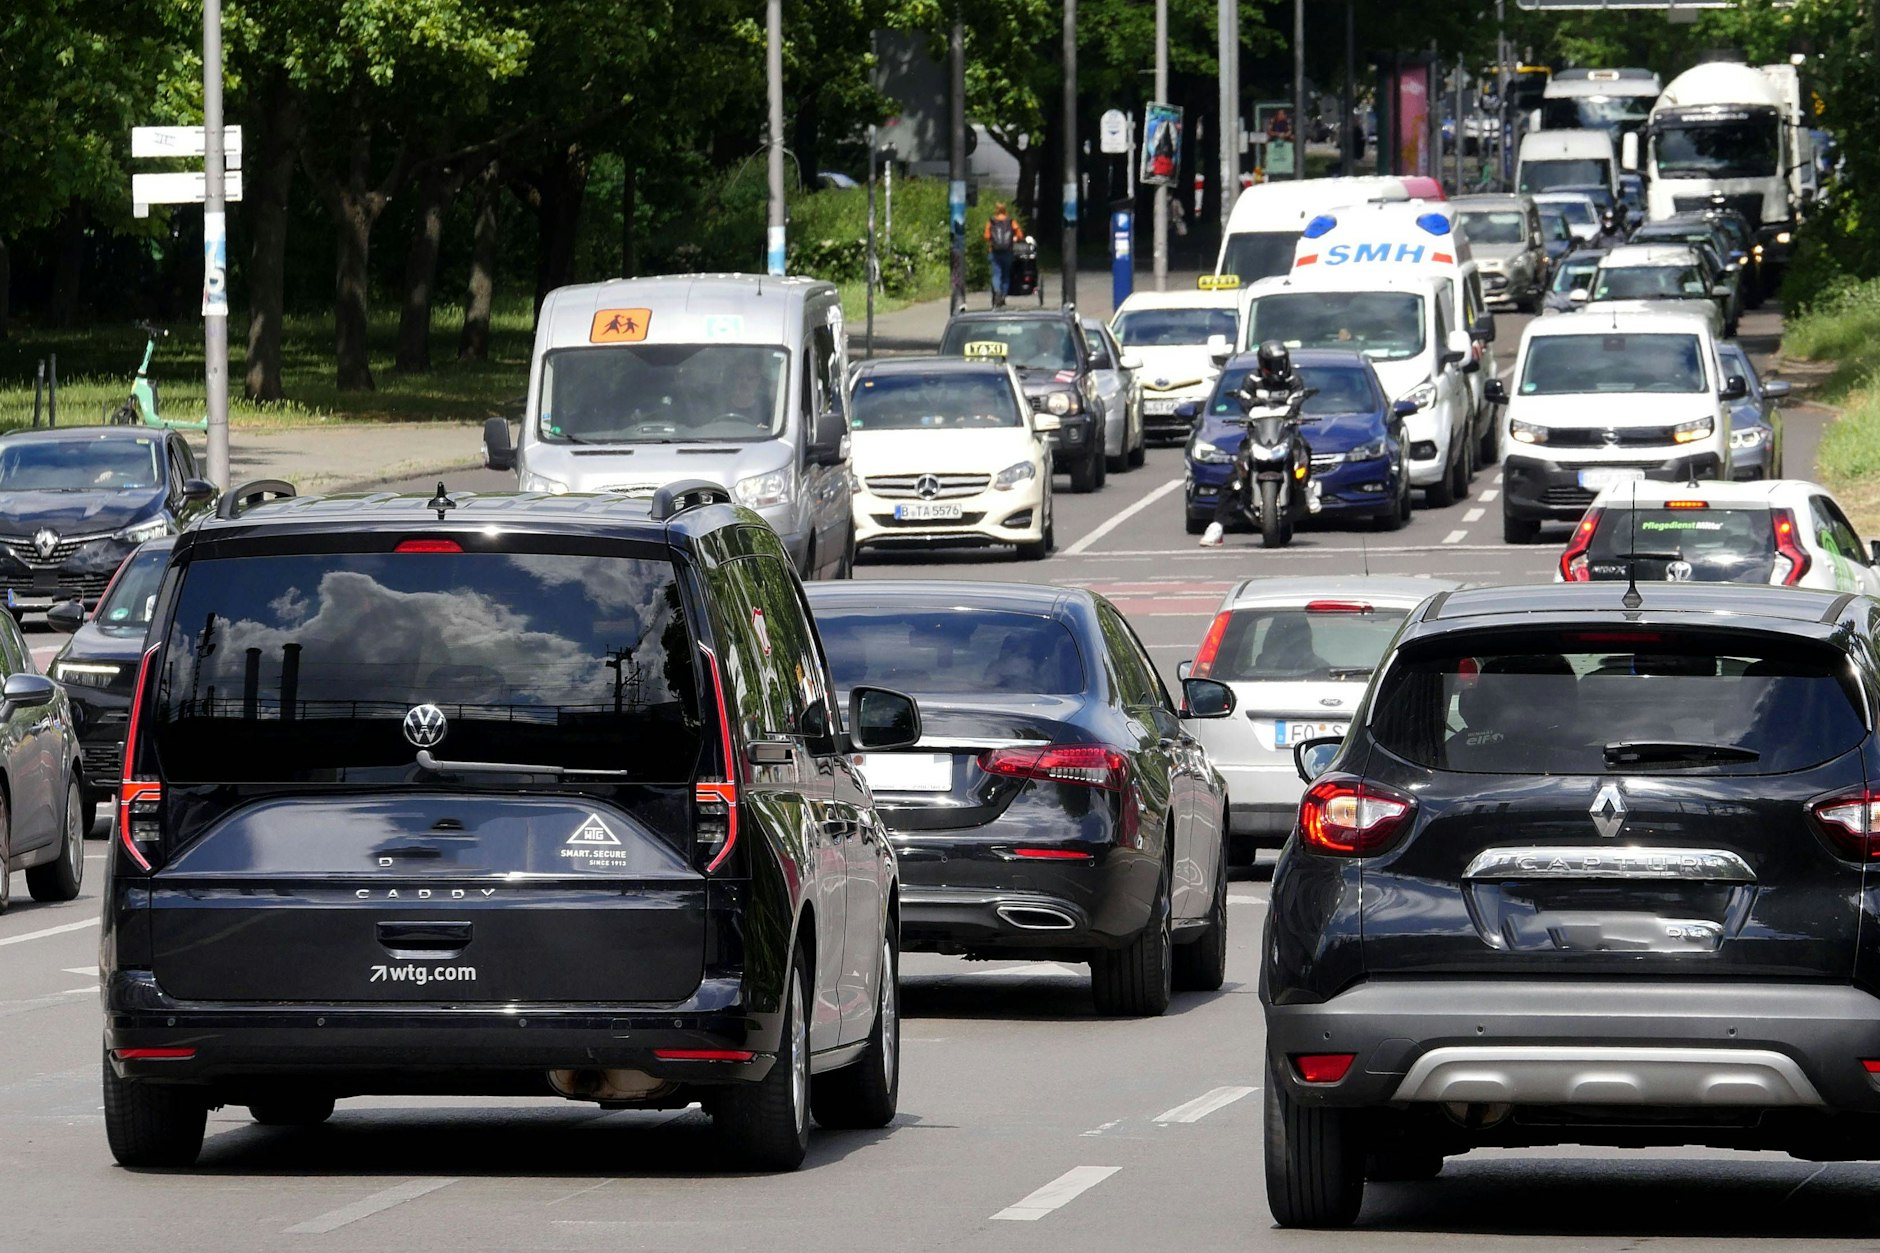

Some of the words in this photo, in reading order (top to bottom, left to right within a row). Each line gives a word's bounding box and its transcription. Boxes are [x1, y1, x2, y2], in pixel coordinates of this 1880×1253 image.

[1325, 243, 1425, 265] SMH
[971, 345, 1002, 354] TAXI
[584, 827, 604, 840] WTG
[1515, 855, 1702, 873] CAPTUR
[355, 889, 496, 899] CADDY
[389, 964, 477, 985] wtg.com
